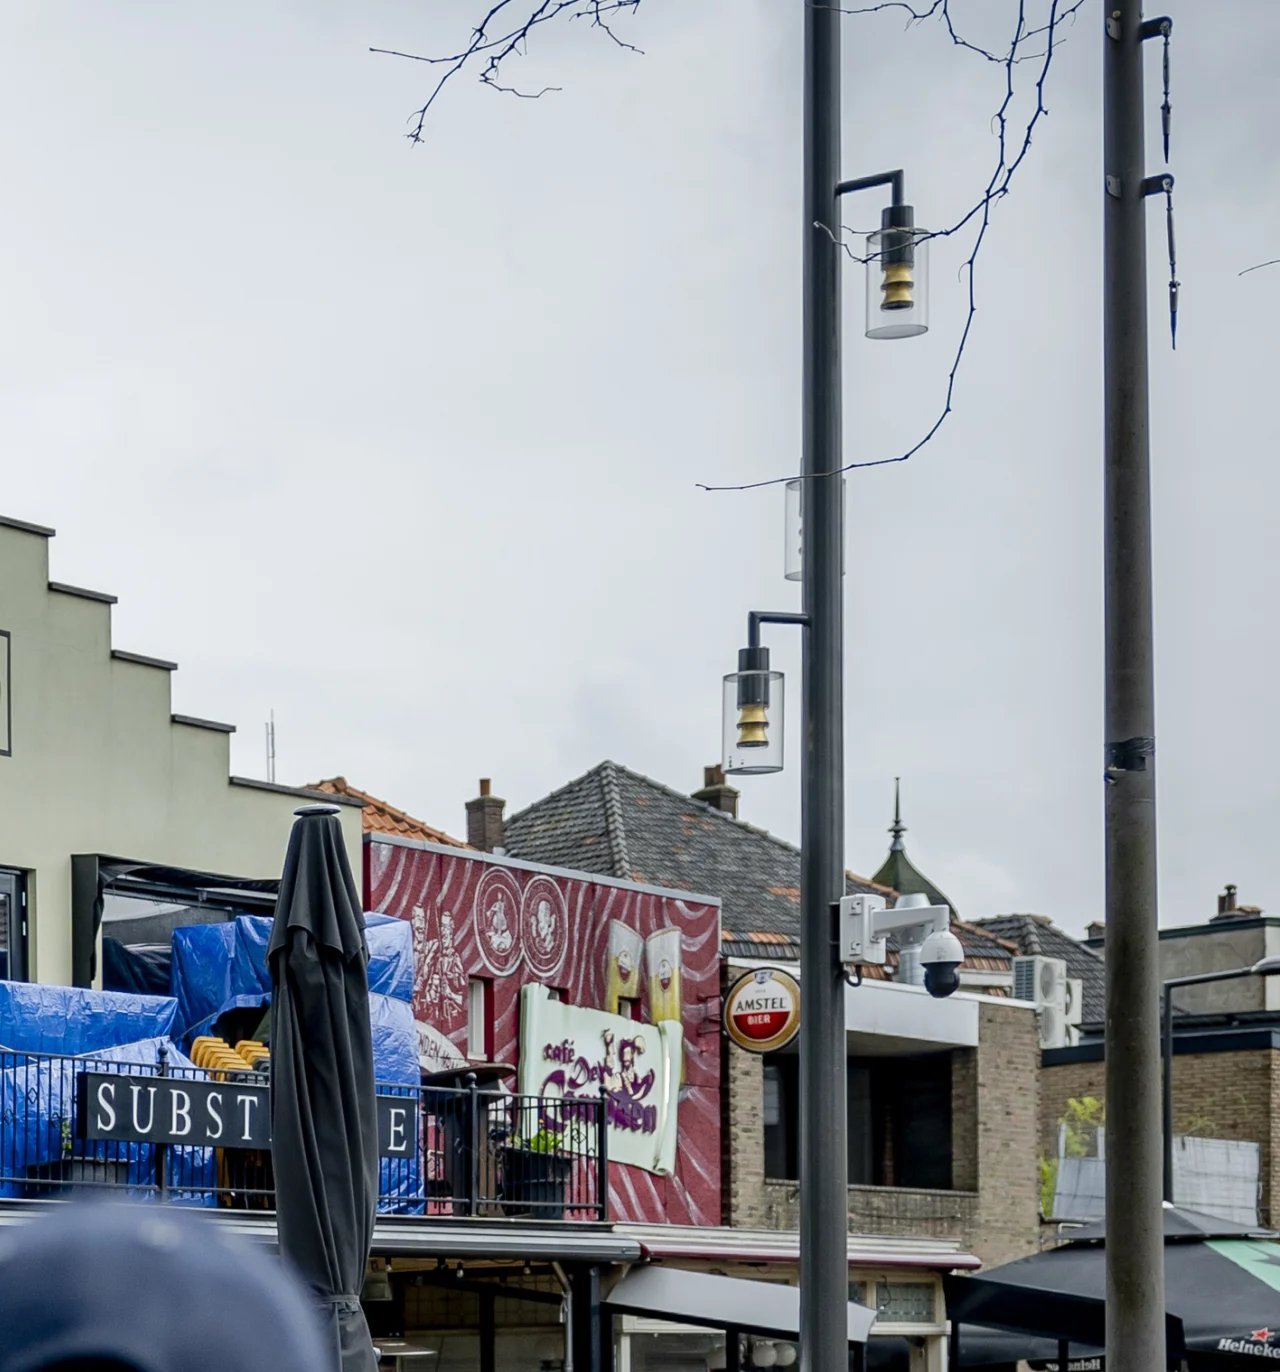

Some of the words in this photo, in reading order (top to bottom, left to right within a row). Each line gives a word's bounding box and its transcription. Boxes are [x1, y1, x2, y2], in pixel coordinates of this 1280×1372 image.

[736, 998, 786, 1011] AMSTEL
[747, 1014, 771, 1025] BIER
[97, 1082, 408, 1152] SUBSTE
[1217, 1338, 1280, 1359] Heineke
